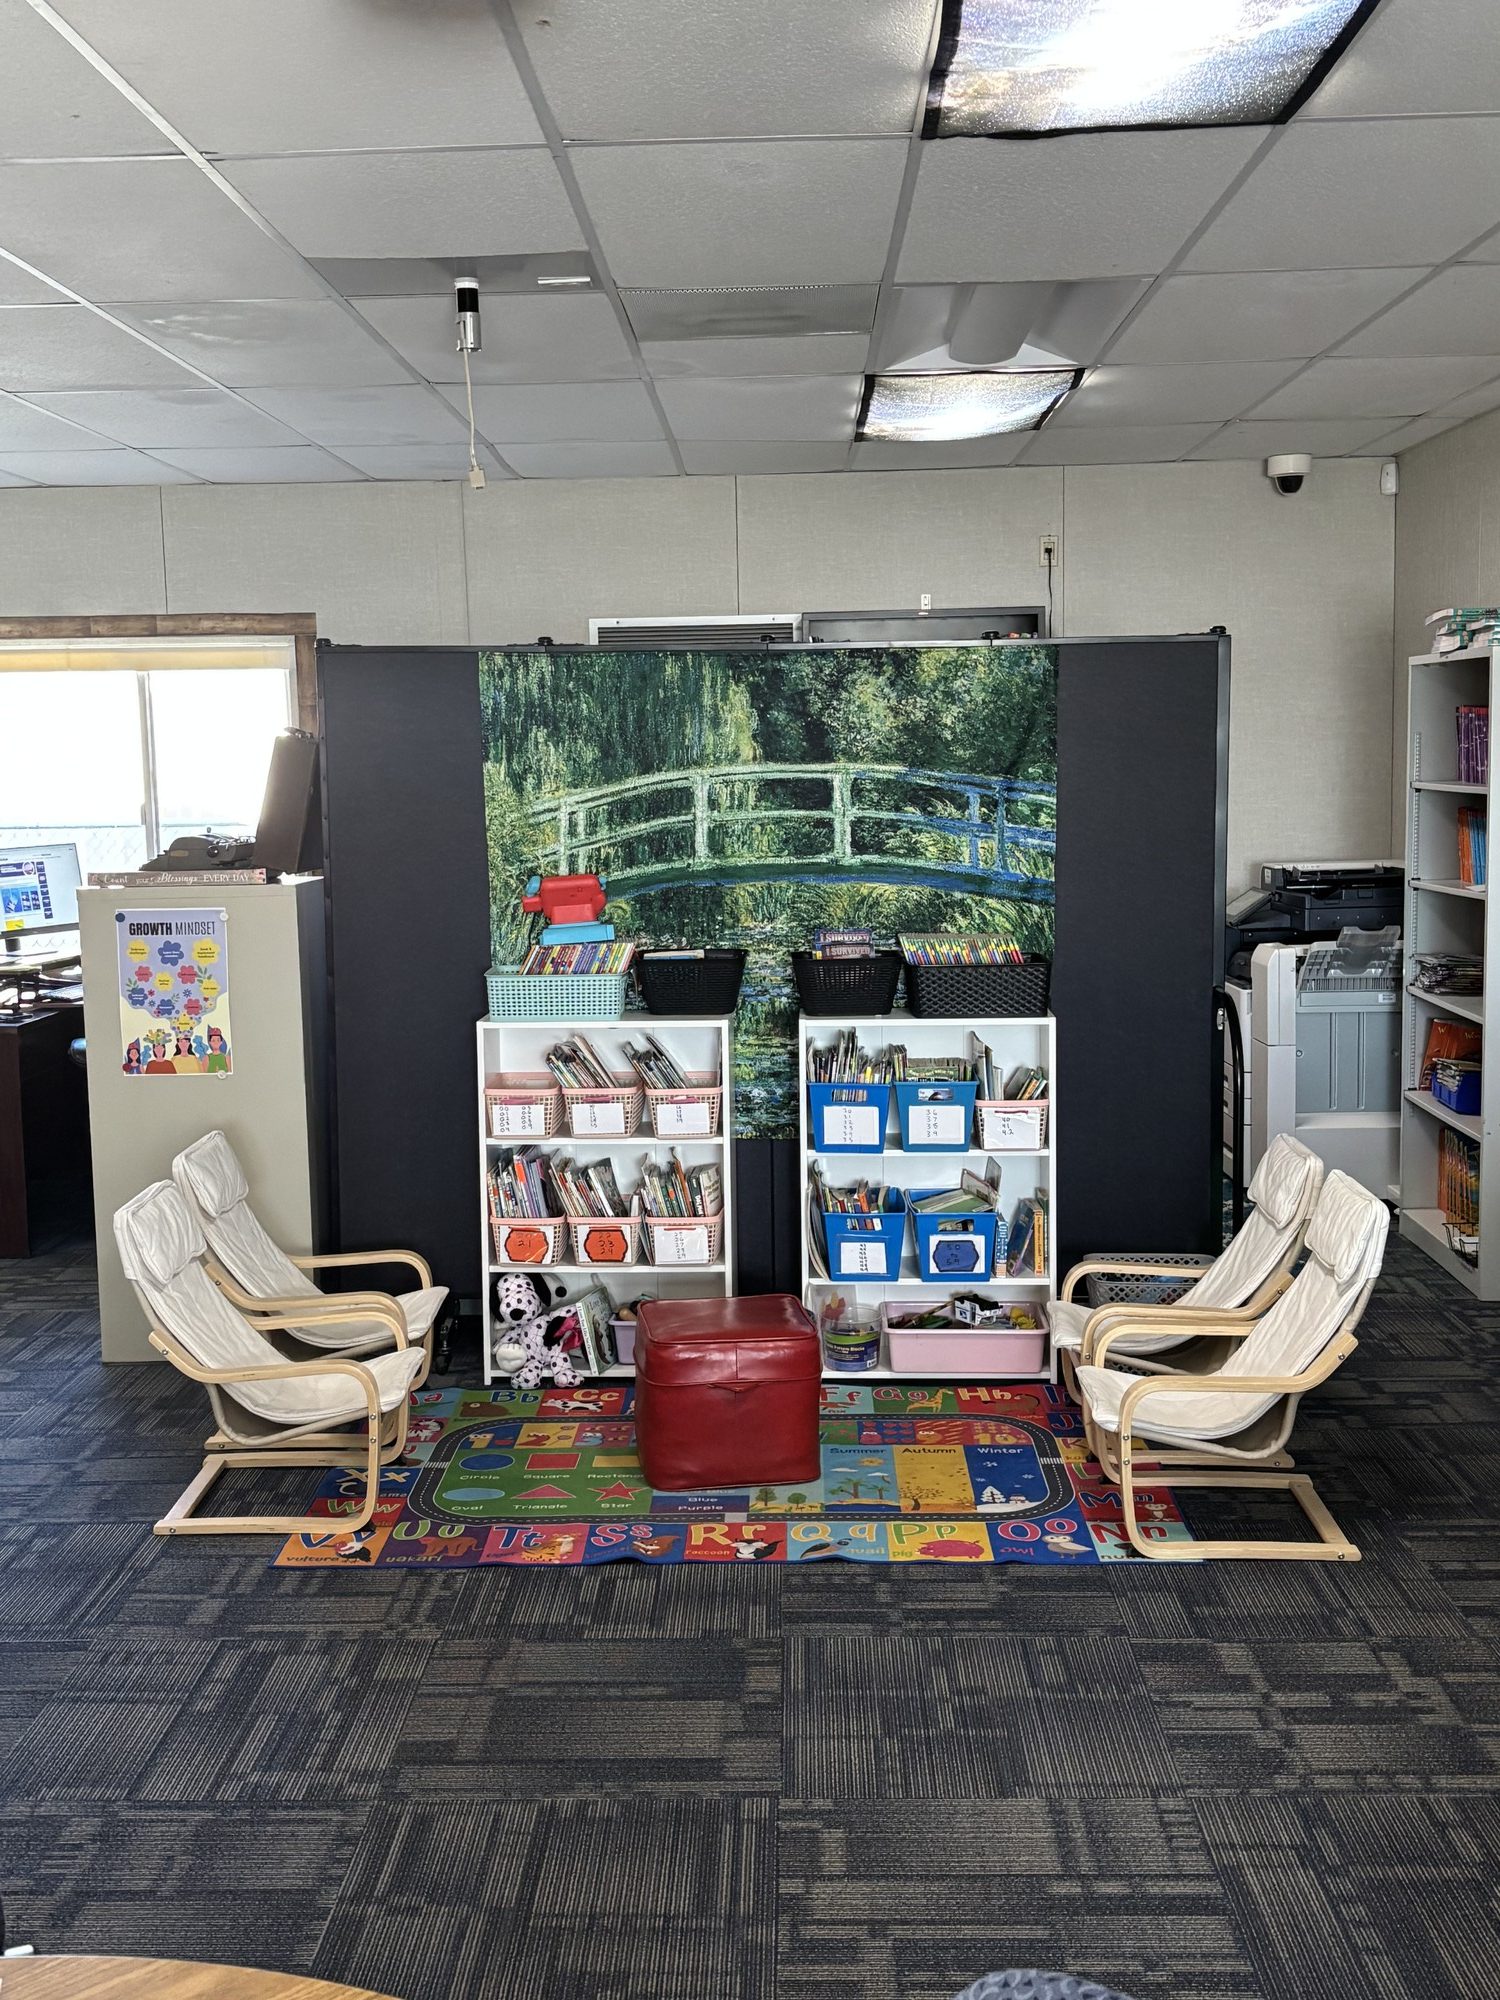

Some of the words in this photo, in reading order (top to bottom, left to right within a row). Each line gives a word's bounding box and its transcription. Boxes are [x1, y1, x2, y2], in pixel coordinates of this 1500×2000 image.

[104, 875, 128, 884] Count
[157, 872, 198, 885] Blessings
[203, 873, 230, 883] EVERY
[233, 872, 250, 882] DAY
[129, 922, 172, 936] GROWTH
[175, 921, 215, 936] MINDSET
[826, 946, 830, 956] I
[831, 946, 871, 955] SURVIVED
[518, 1240, 531, 1248] 21
[977, 1446, 1024, 1454] Winter
[892, 1550, 913, 1558] pig
[1000, 1546, 1035, 1557] owl
[385, 1555, 442, 1563] uakari
